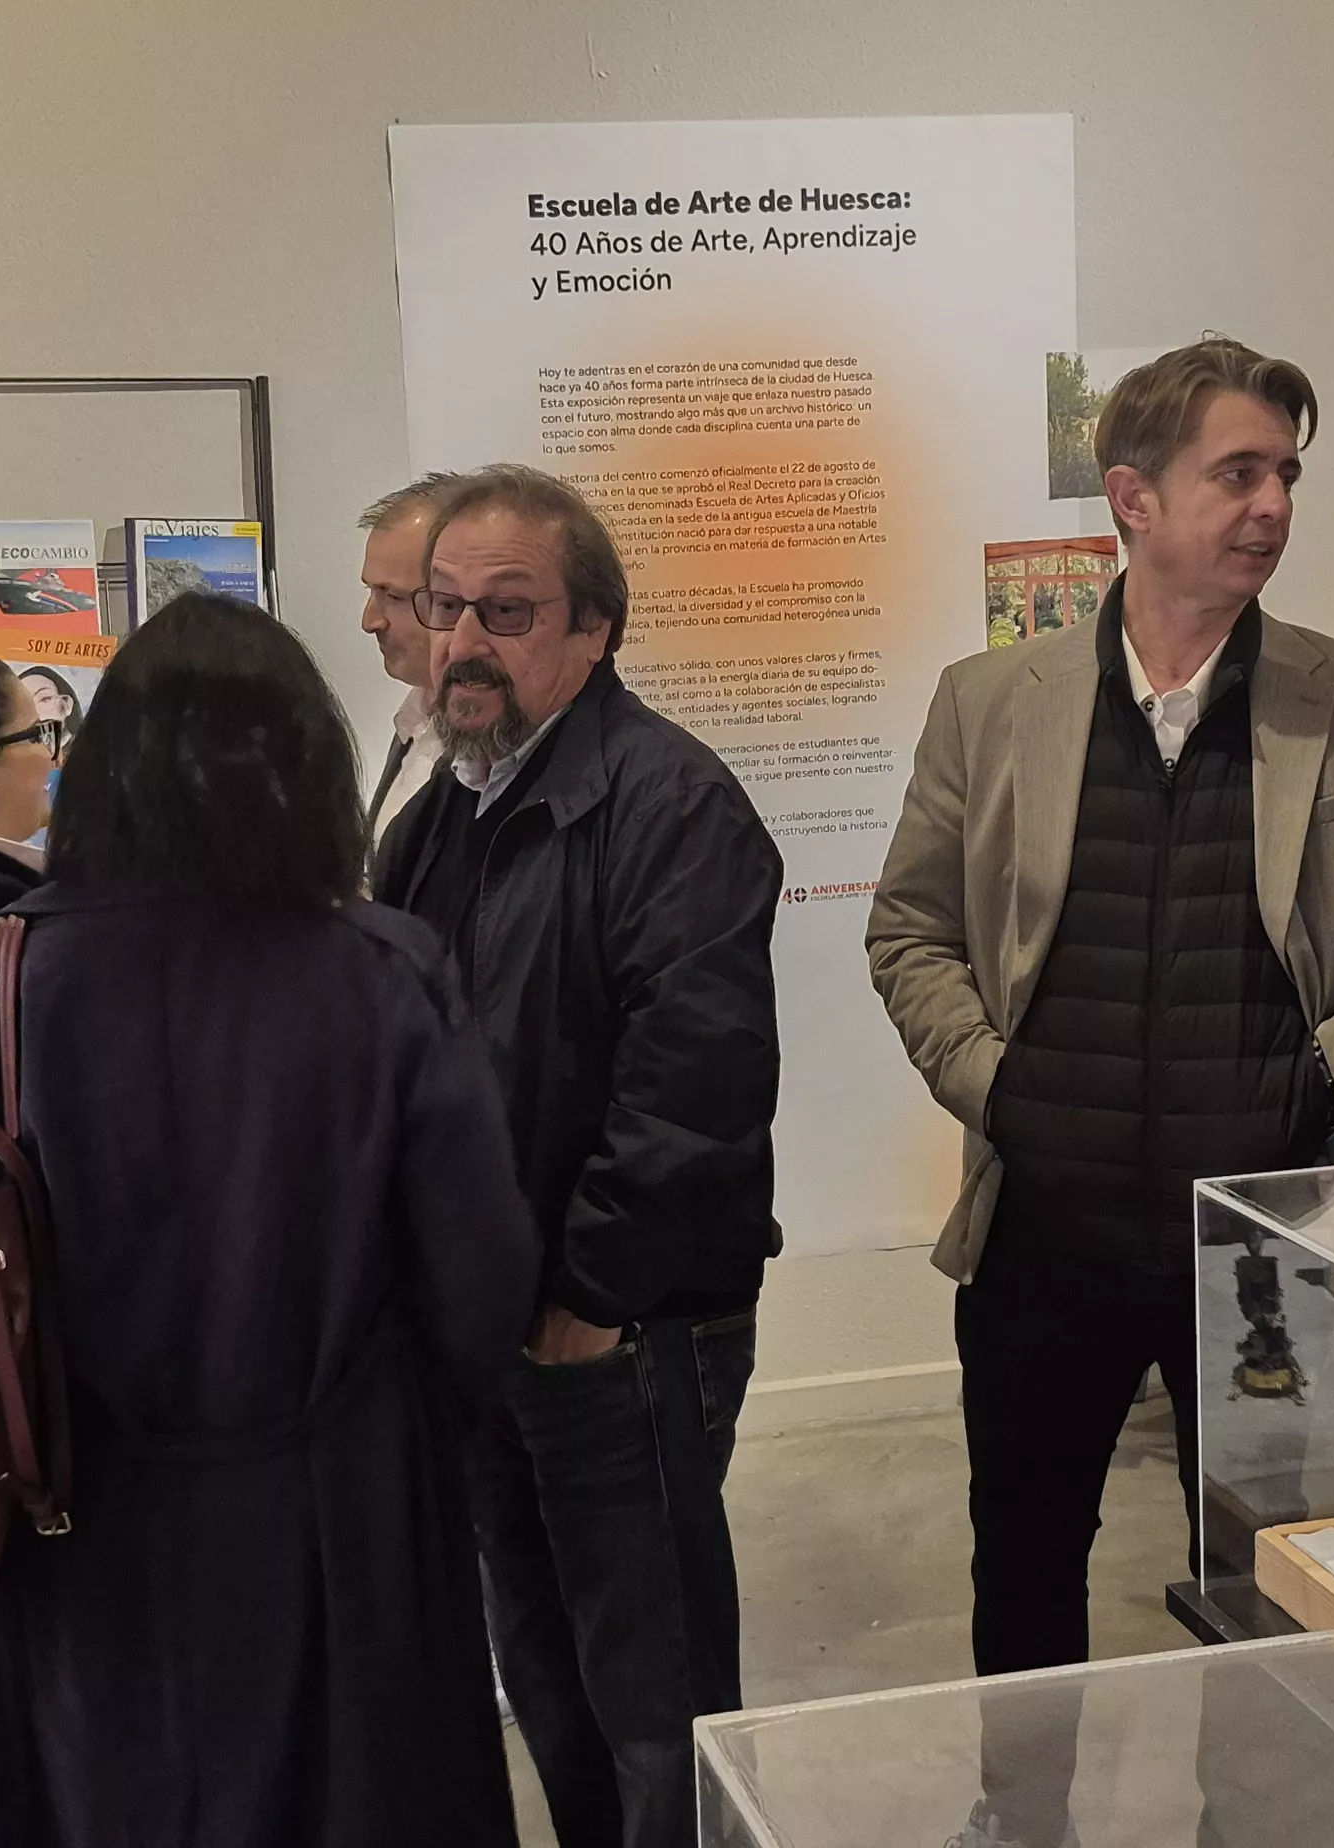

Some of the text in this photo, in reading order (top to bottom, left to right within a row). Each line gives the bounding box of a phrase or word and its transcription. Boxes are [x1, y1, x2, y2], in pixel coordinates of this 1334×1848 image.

[528, 187, 912, 218] Escuela de Arte de Huesca:
[530, 223, 917, 256] 40 Años de Arte, Aprendizaje
[531, 267, 672, 300] y Emoción
[538, 356, 857, 380] Hoy te adentras en el corazón de una comunidad que desde
[539, 370, 873, 395] hace ya 40 años forma parte intrínseca de la ciudad de Huesca.
[540, 385, 872, 410] Esta exposición representa un viaje que enlaza nuestro pasado
[539, 400, 872, 424] con el futuro, mostrando algo más que un archivo histórico: un
[541, 415, 861, 440] espacio con alma donde cada disciplina cuenta una parte de
[542, 442, 617, 455] lo que somos.
[0, 547, 89, 560] ECOCAMBIO
[27, 639, 111, 659] SOY DE ARTES
[782, 735, 880, 750] de estudiantes que
[762, 747, 897, 766] su formación o reinventar-
[754, 761, 894, 783] sigue presente con nuestro
[770, 807, 874, 825] y colaboradores que
[839, 817, 887, 832] la historia
[811, 881, 880, 895] ANIVERSAR
